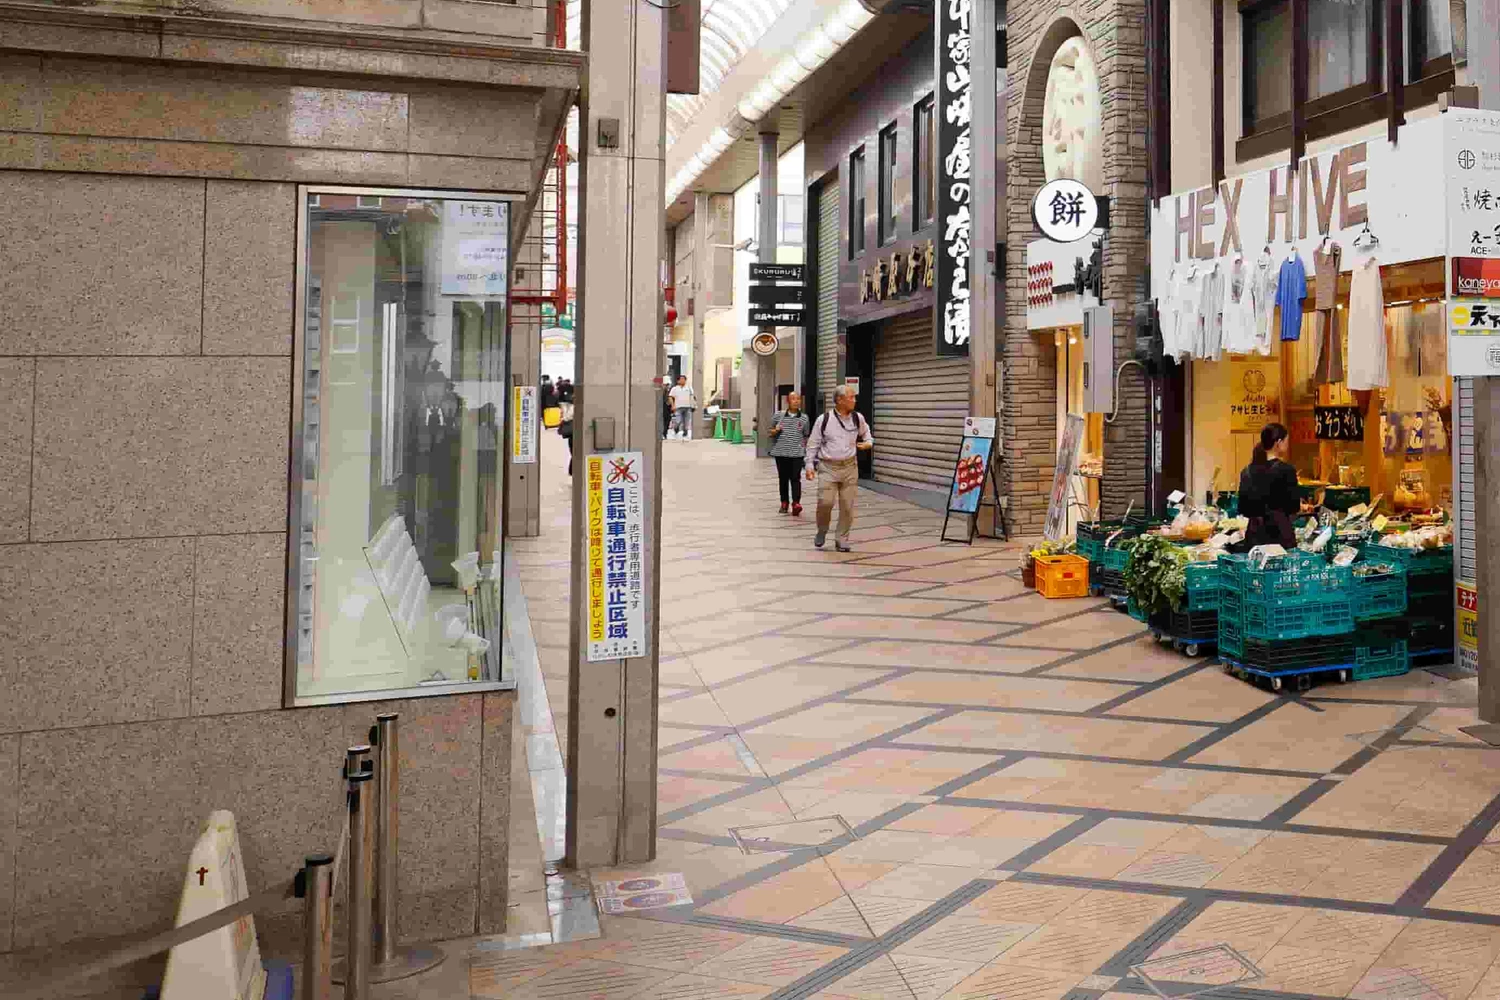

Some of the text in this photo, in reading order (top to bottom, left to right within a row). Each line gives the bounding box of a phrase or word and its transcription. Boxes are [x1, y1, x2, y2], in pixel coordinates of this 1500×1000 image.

[1049, 190, 1086, 228] 餅
[1175, 141, 1368, 263] HEX HIVE
[606, 487, 627, 639] 自転車通行禁止区域
